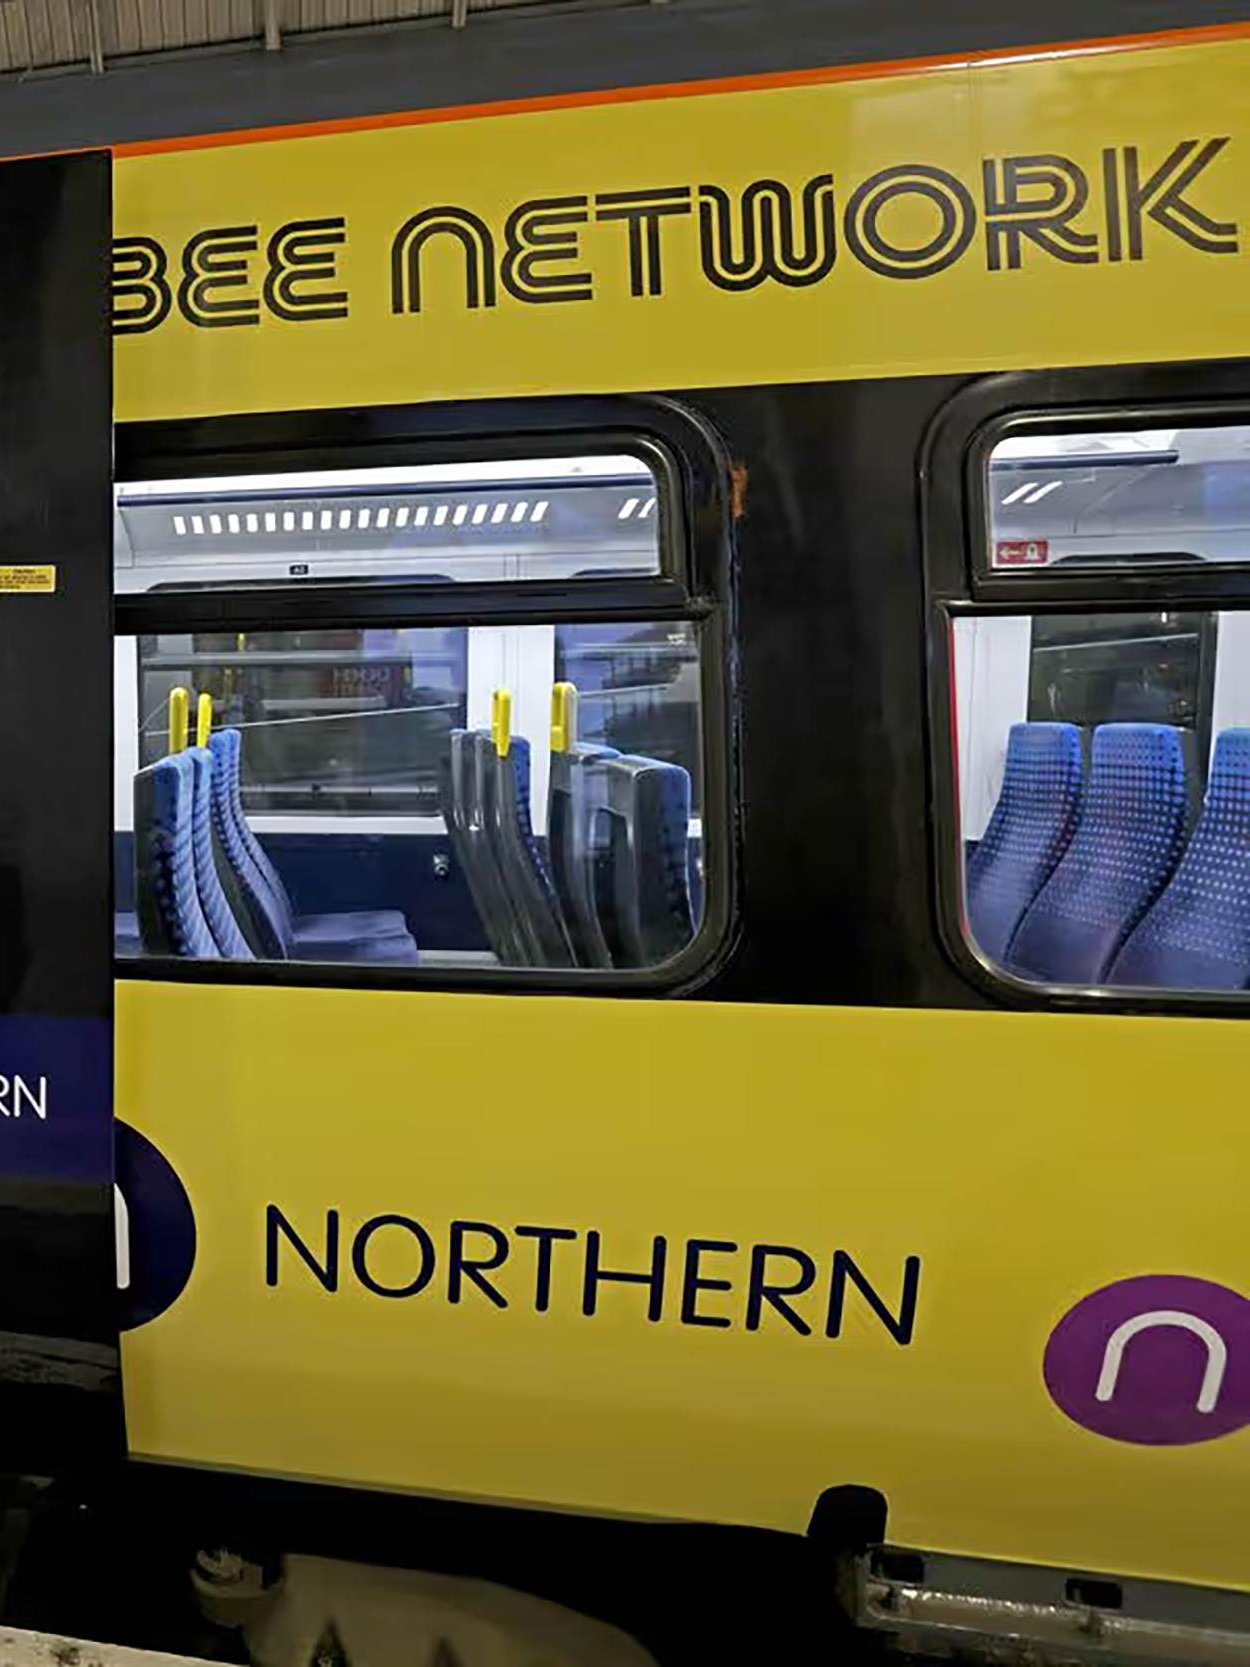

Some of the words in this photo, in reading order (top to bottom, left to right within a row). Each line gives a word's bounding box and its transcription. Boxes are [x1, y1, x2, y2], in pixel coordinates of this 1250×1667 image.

[112, 217, 349, 335] BEE
[391, 136, 1239, 314] NETWORK
[264, 1203, 922, 1346] NORTHERN
